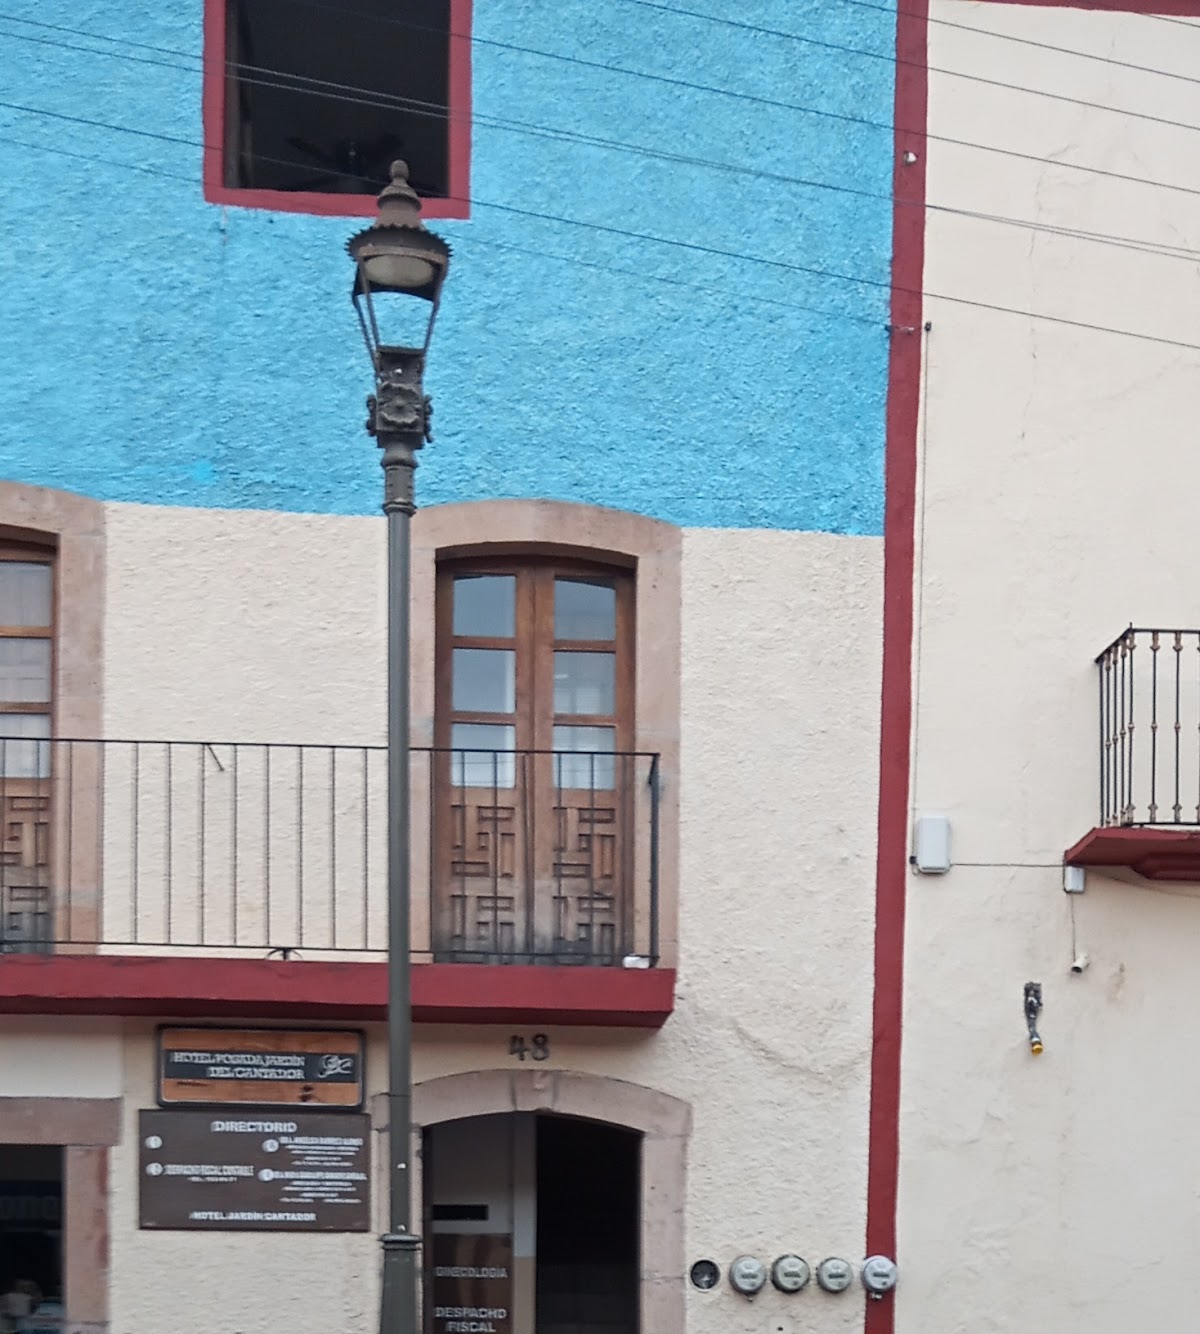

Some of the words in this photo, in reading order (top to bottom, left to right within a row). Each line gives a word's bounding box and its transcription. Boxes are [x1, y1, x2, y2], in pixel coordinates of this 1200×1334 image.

[509, 1033, 550, 1061] 48
[172, 1052, 215, 1064] HOTEL
[211, 1120, 298, 1133] DIRECTORIO
[189, 1211, 225, 1221] HOTEL
[434, 1307, 508, 1319] DESPACHO
[445, 1321, 497, 1333] FISCAL
